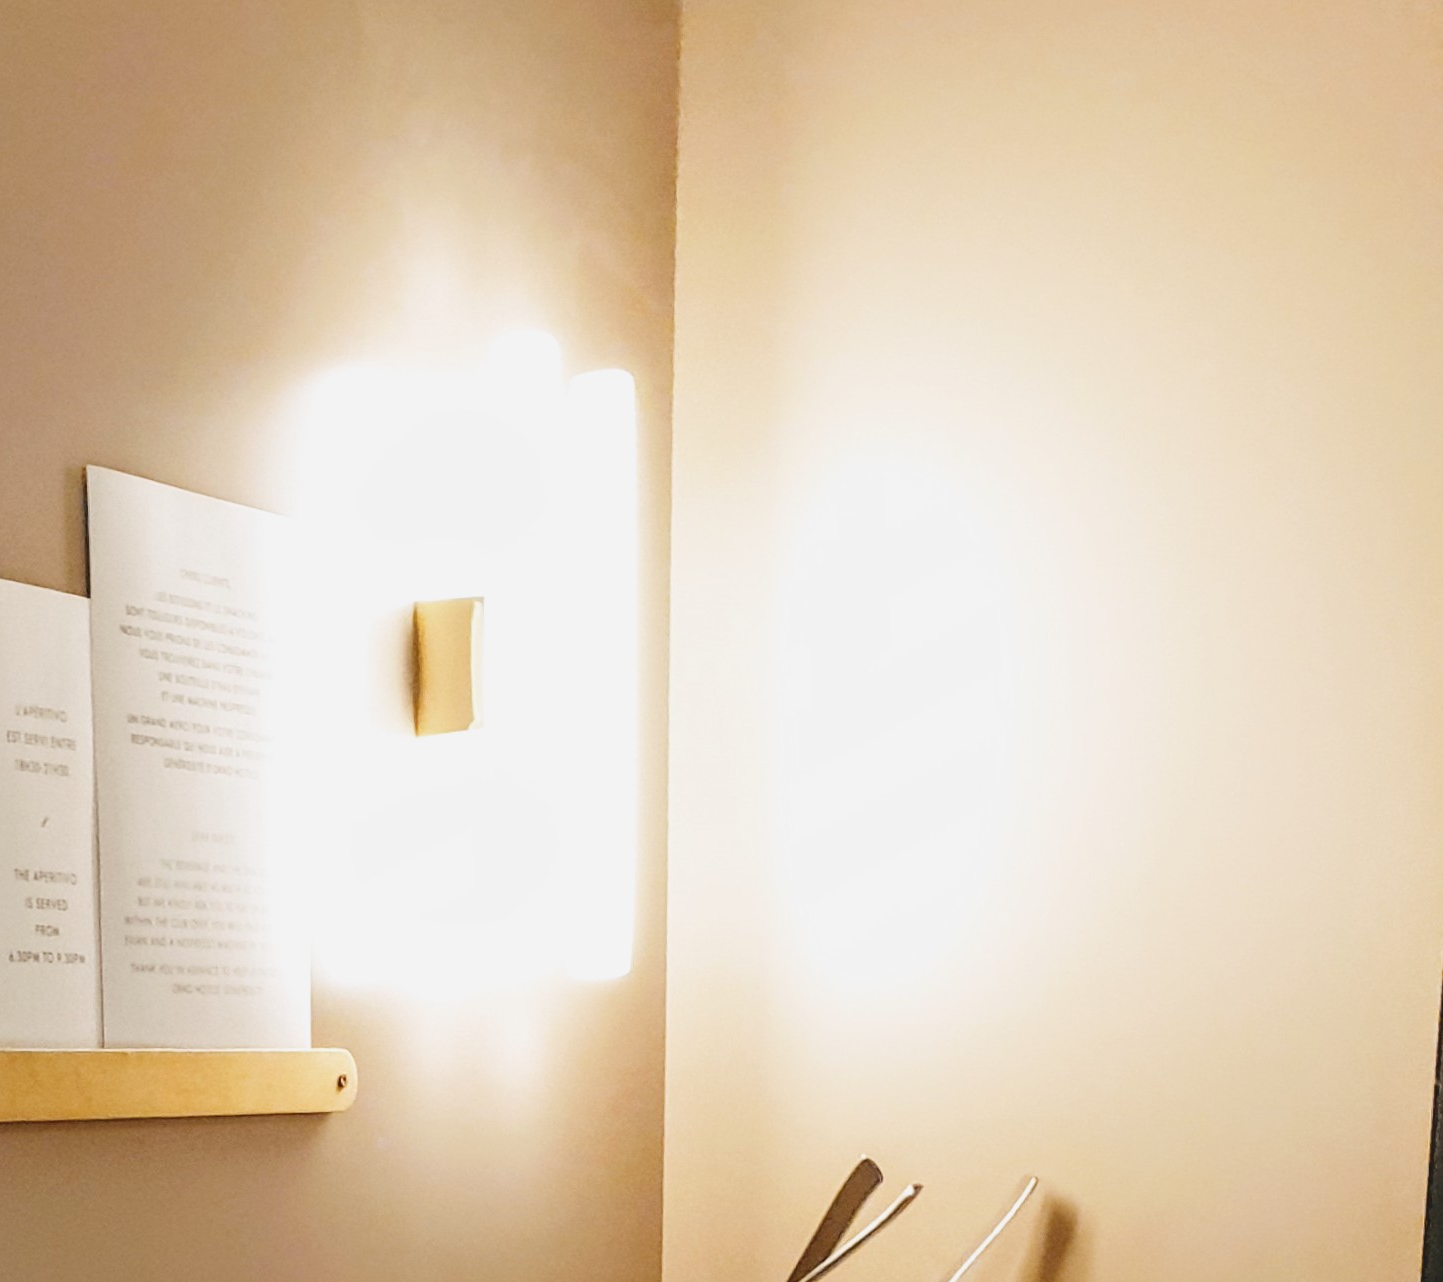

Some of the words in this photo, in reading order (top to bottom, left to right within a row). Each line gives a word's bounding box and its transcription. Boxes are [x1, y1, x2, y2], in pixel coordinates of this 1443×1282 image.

[14, 868, 29, 882] THE
[36, 897, 68, 911] SERVED
[35, 924, 60, 937] FROM
[43, 951, 54, 963] TO
